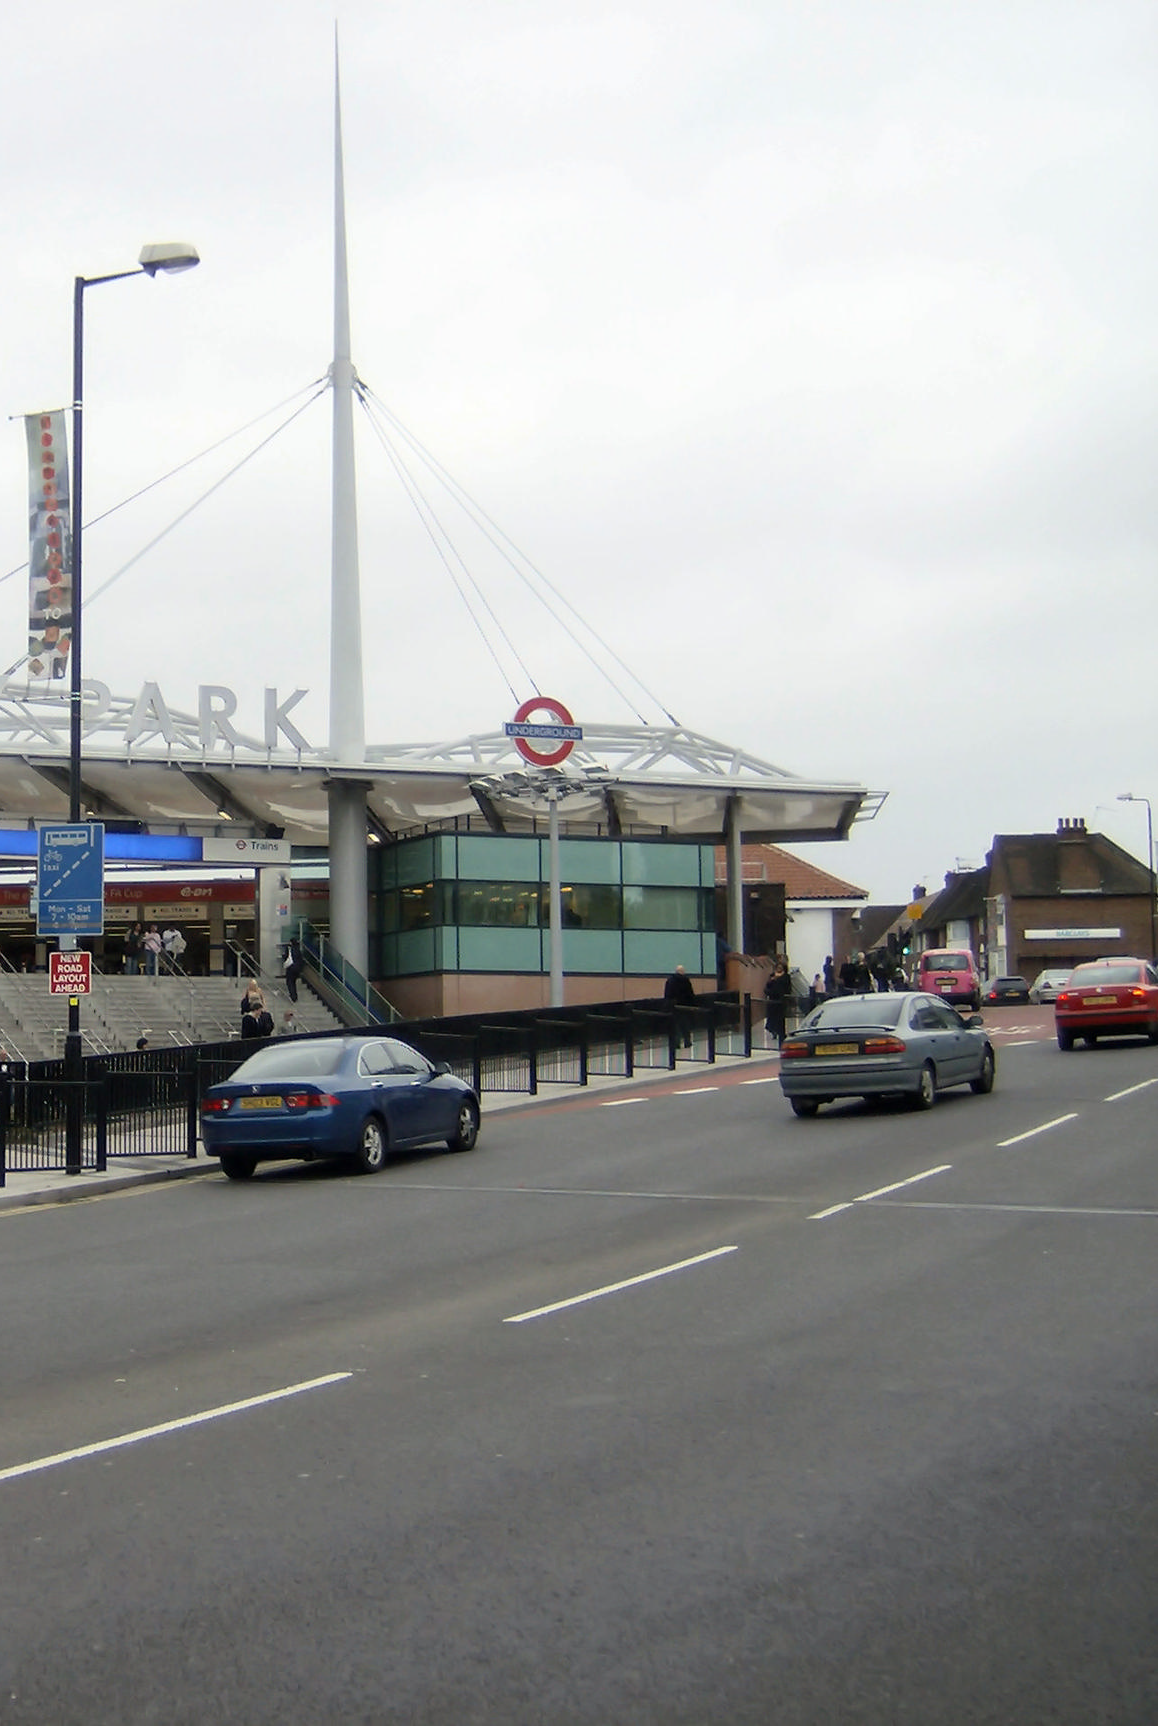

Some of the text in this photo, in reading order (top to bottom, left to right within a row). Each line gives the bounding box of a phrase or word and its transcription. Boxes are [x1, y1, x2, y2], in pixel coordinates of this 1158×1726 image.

[72, 678, 313, 750] PARK
[507, 725, 581, 738] UNDERGROUND
[251, 841, 279, 851] Trains
[48, 904, 66, 912] Mon
[76, 904, 92, 912] Sat
[60, 954, 81, 963] NEW
[57, 964, 83, 973] ROAD
[53, 974, 87, 983] LAYOUT
[55, 984, 86, 992] AHEAD
